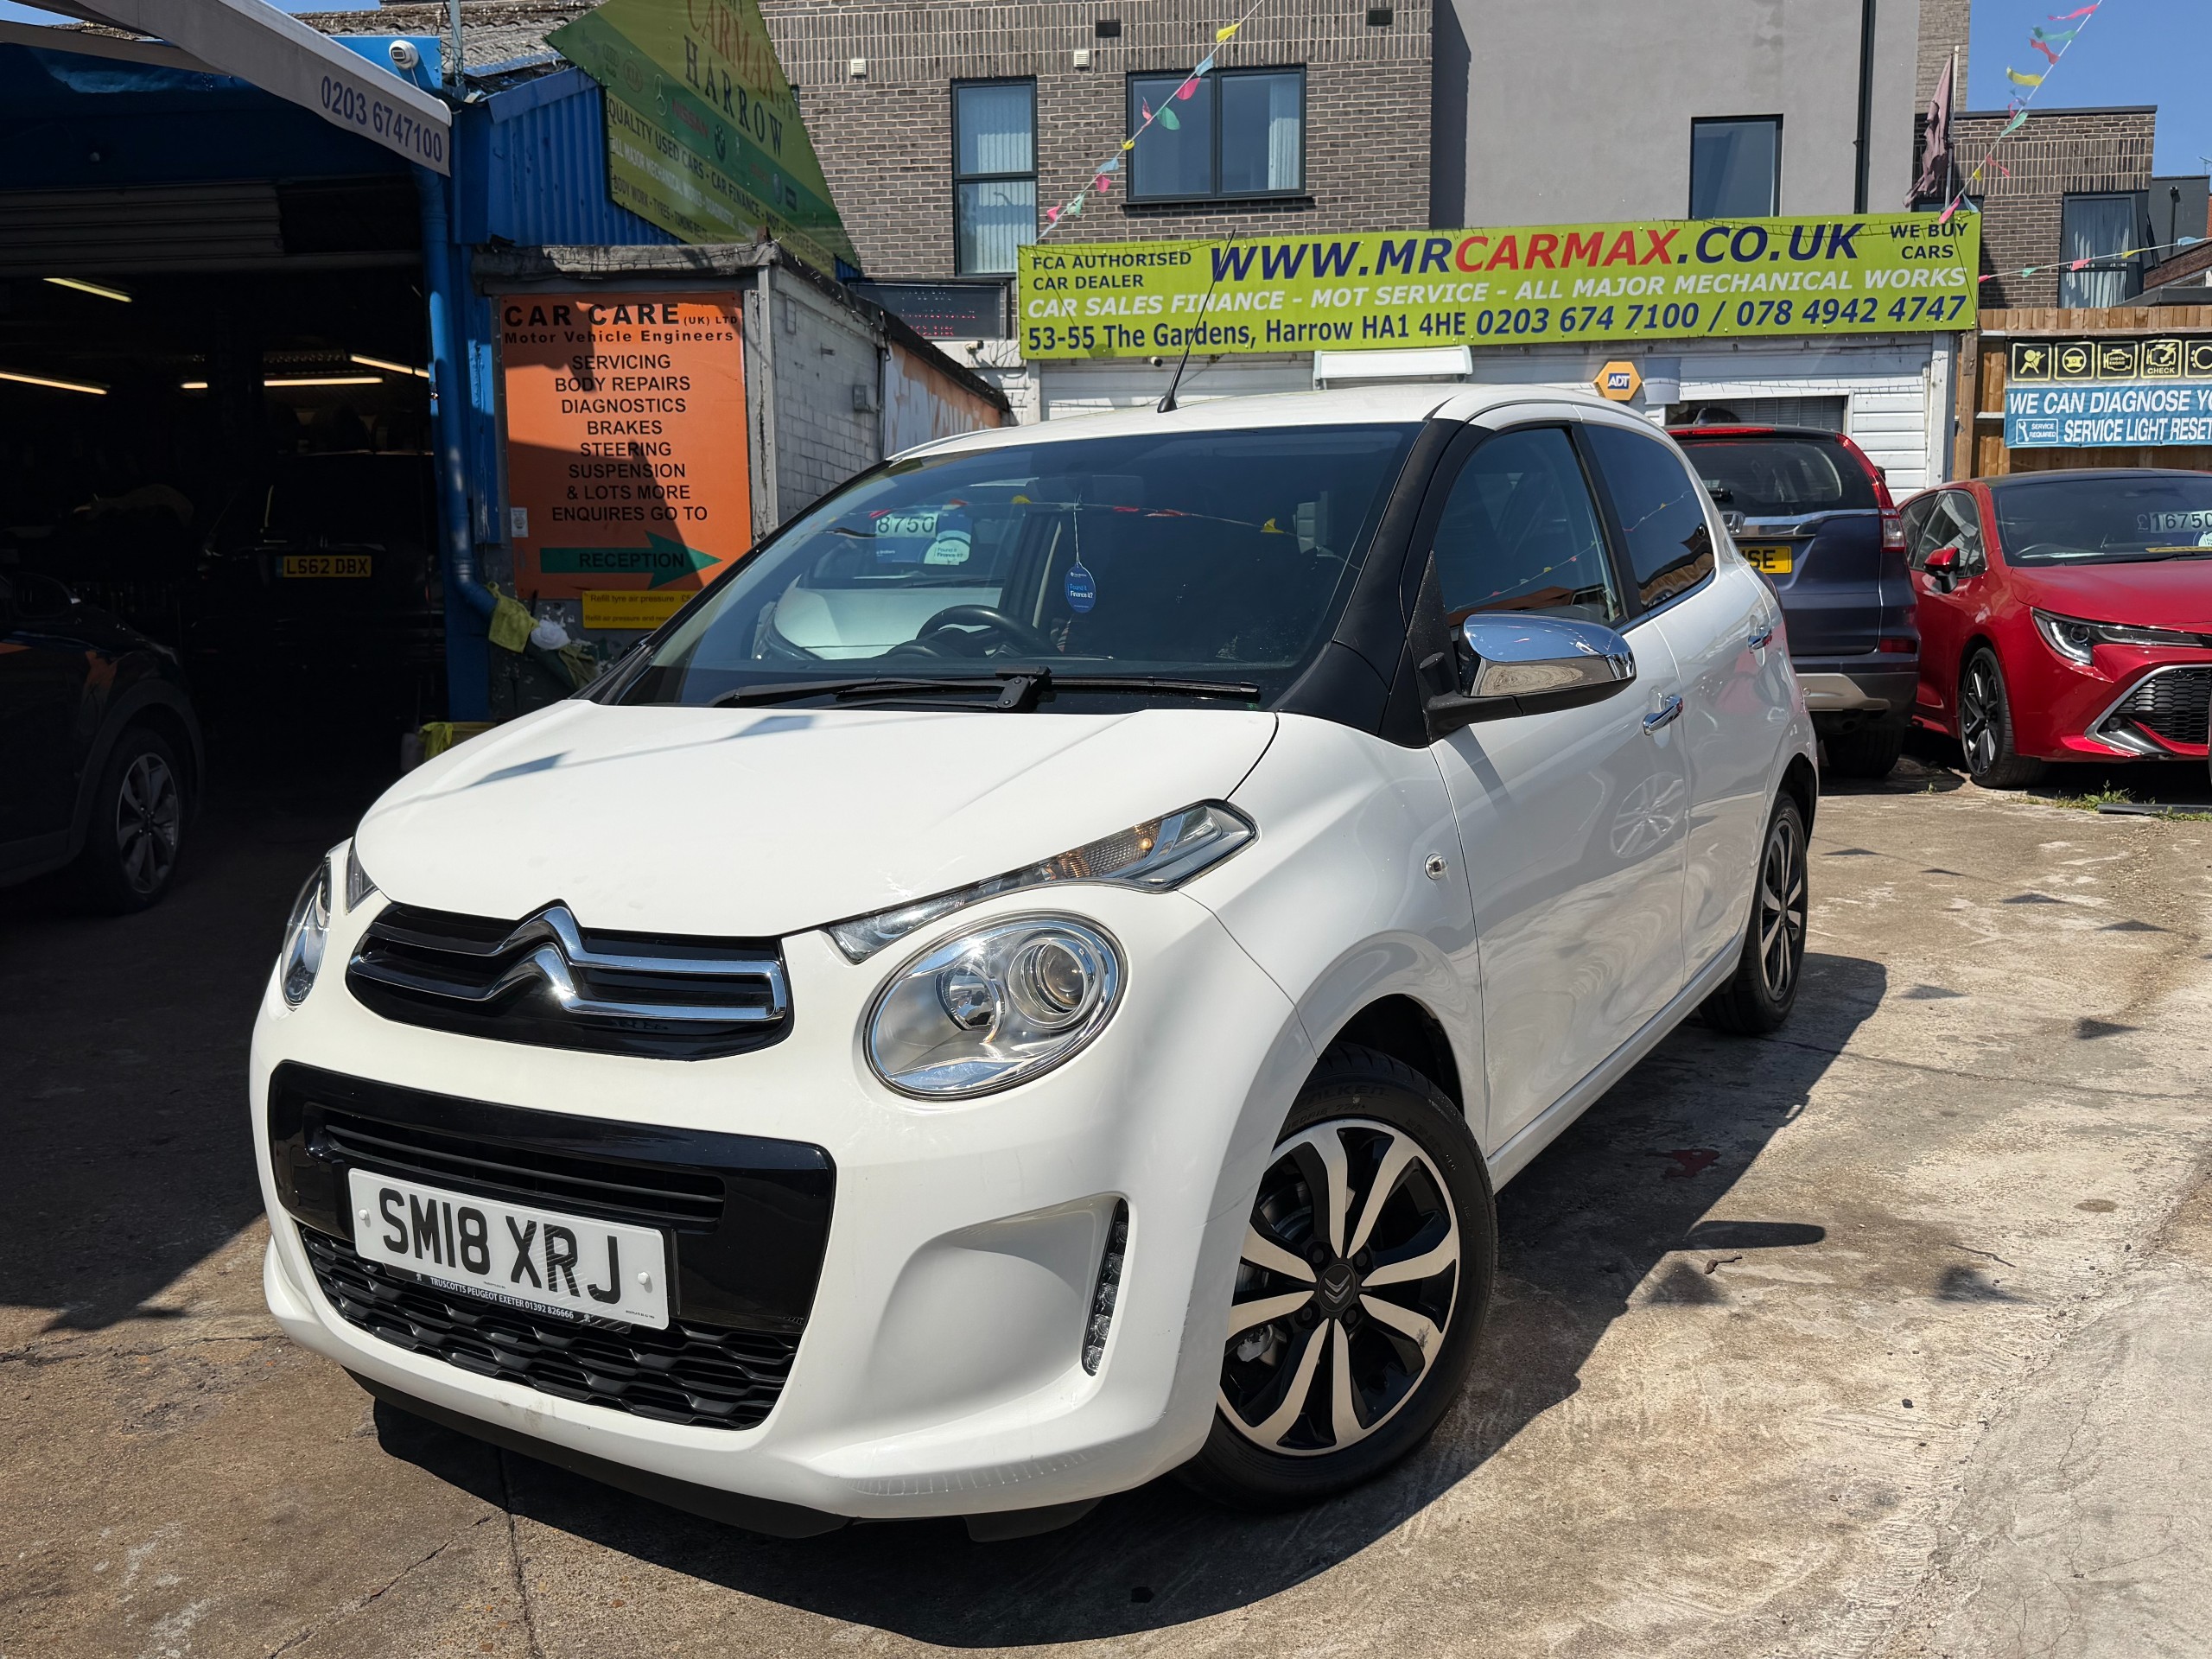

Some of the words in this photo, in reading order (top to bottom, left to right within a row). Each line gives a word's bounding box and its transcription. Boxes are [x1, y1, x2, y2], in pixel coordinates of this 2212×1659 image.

[684, 35, 782, 158] HARROW
[321, 75, 367, 125] 0203
[372, 101, 442, 162] 6747100
[608, 99, 652, 143] QUALITY
[656, 132, 679, 162] USED
[682, 150, 703, 180] CARS
[711, 170, 727, 196] CAR
[729, 181, 760, 219] FINANCE
[631, 185, 649, 208] WORK
[1890, 224, 1920, 239] WE
[1927, 222, 1969, 238] BUY
[1033, 255, 1068, 270] FCA
[1073, 251, 1192, 269] AUTHORISED
[1211, 222, 1866, 283] WWW.MRCARMAX.CO.UK
[1901, 245, 1954, 260] CARS
[1033, 276, 1068, 291] CAR
[1076, 274, 1144, 289] DEALER
[1027, 298, 1077, 318] CAR
[1085, 295, 1164, 316] SALES
[1170, 290, 1286, 313] FINANCE
[1310, 287, 1366, 309] MOT
[1374, 282, 1490, 304] SERVICE
[1515, 280, 1565, 301] ALL
[1572, 276, 1665, 299] MAJOR
[1671, 270, 1853, 295] MECHANICAL
[1863, 268, 1967, 289] WORKS
[504, 304, 572, 327] CAR
[588, 302, 680, 326] CARE
[683, 315, 710, 327] (UK)
[715, 315, 738, 325] LTD
[1028, 326, 1096, 352] 53-55
[1103, 324, 1146, 349] The
[1154, 321, 1256, 349] Gardens,
[1266, 316, 1354, 344] Harrow
[1362, 315, 1409, 340] HA1
[1419, 312, 1467, 337] 4HE
[1476, 307, 1549, 335] 0203
[1559, 305, 1614, 333] 674
[1624, 302, 1699, 329] 7100
[1736, 299, 1792, 326] 078
[1802, 296, 1878, 325] 4942
[1887, 295, 1967, 323] 4747
[505, 331, 556, 344] Motor
[563, 329, 632, 344] Vehicle
[640, 329, 734, 344] Engineers
[572, 354, 671, 370] SERVICING
[555, 377, 607, 392] BODY
[612, 376, 691, 391] REPAIRS
[1607, 375, 1630, 387] ADT
[561, 398, 687, 414] DIAGNOSTICS
[2010, 392, 2039, 415] WE
[2044, 391, 2085, 414] CAN
[2089, 390, 2192, 413] DIAGNOSE
[587, 420, 663, 435] BRAKES
[2063, 419, 2123, 442] SERVICE
[2126, 417, 2169, 442] LIGHT
[580, 442, 672, 457] STEERING
[568, 463, 686, 479] SUSPENSION
[567, 485, 578, 499] &
[584, 484, 632, 500] LOTS
[637, 484, 690, 499] MORE
[552, 506, 645, 522] ENQUIRES
[650, 505, 677, 521] GO
[683, 506, 709, 521] TO
[878, 516, 935, 533] 8750
[287, 558, 330, 575] LS62
[334, 558, 368, 575] DBX
[579, 551, 685, 569] RECEPTION
[1742, 550, 1777, 569] SE
[640, 595, 675, 604] pressure
[378, 1186, 492, 1277] SM18
[505, 1214, 622, 1305] XRJ
[429, 1276, 467, 1295] TRUSCOTTS
[467, 1287, 499, 1302] PEUGEOT
[499, 1294, 524, 1308] EXETER
[524, 1300, 547, 1313] 01392
[547, 1306, 575, 1320] 826666
